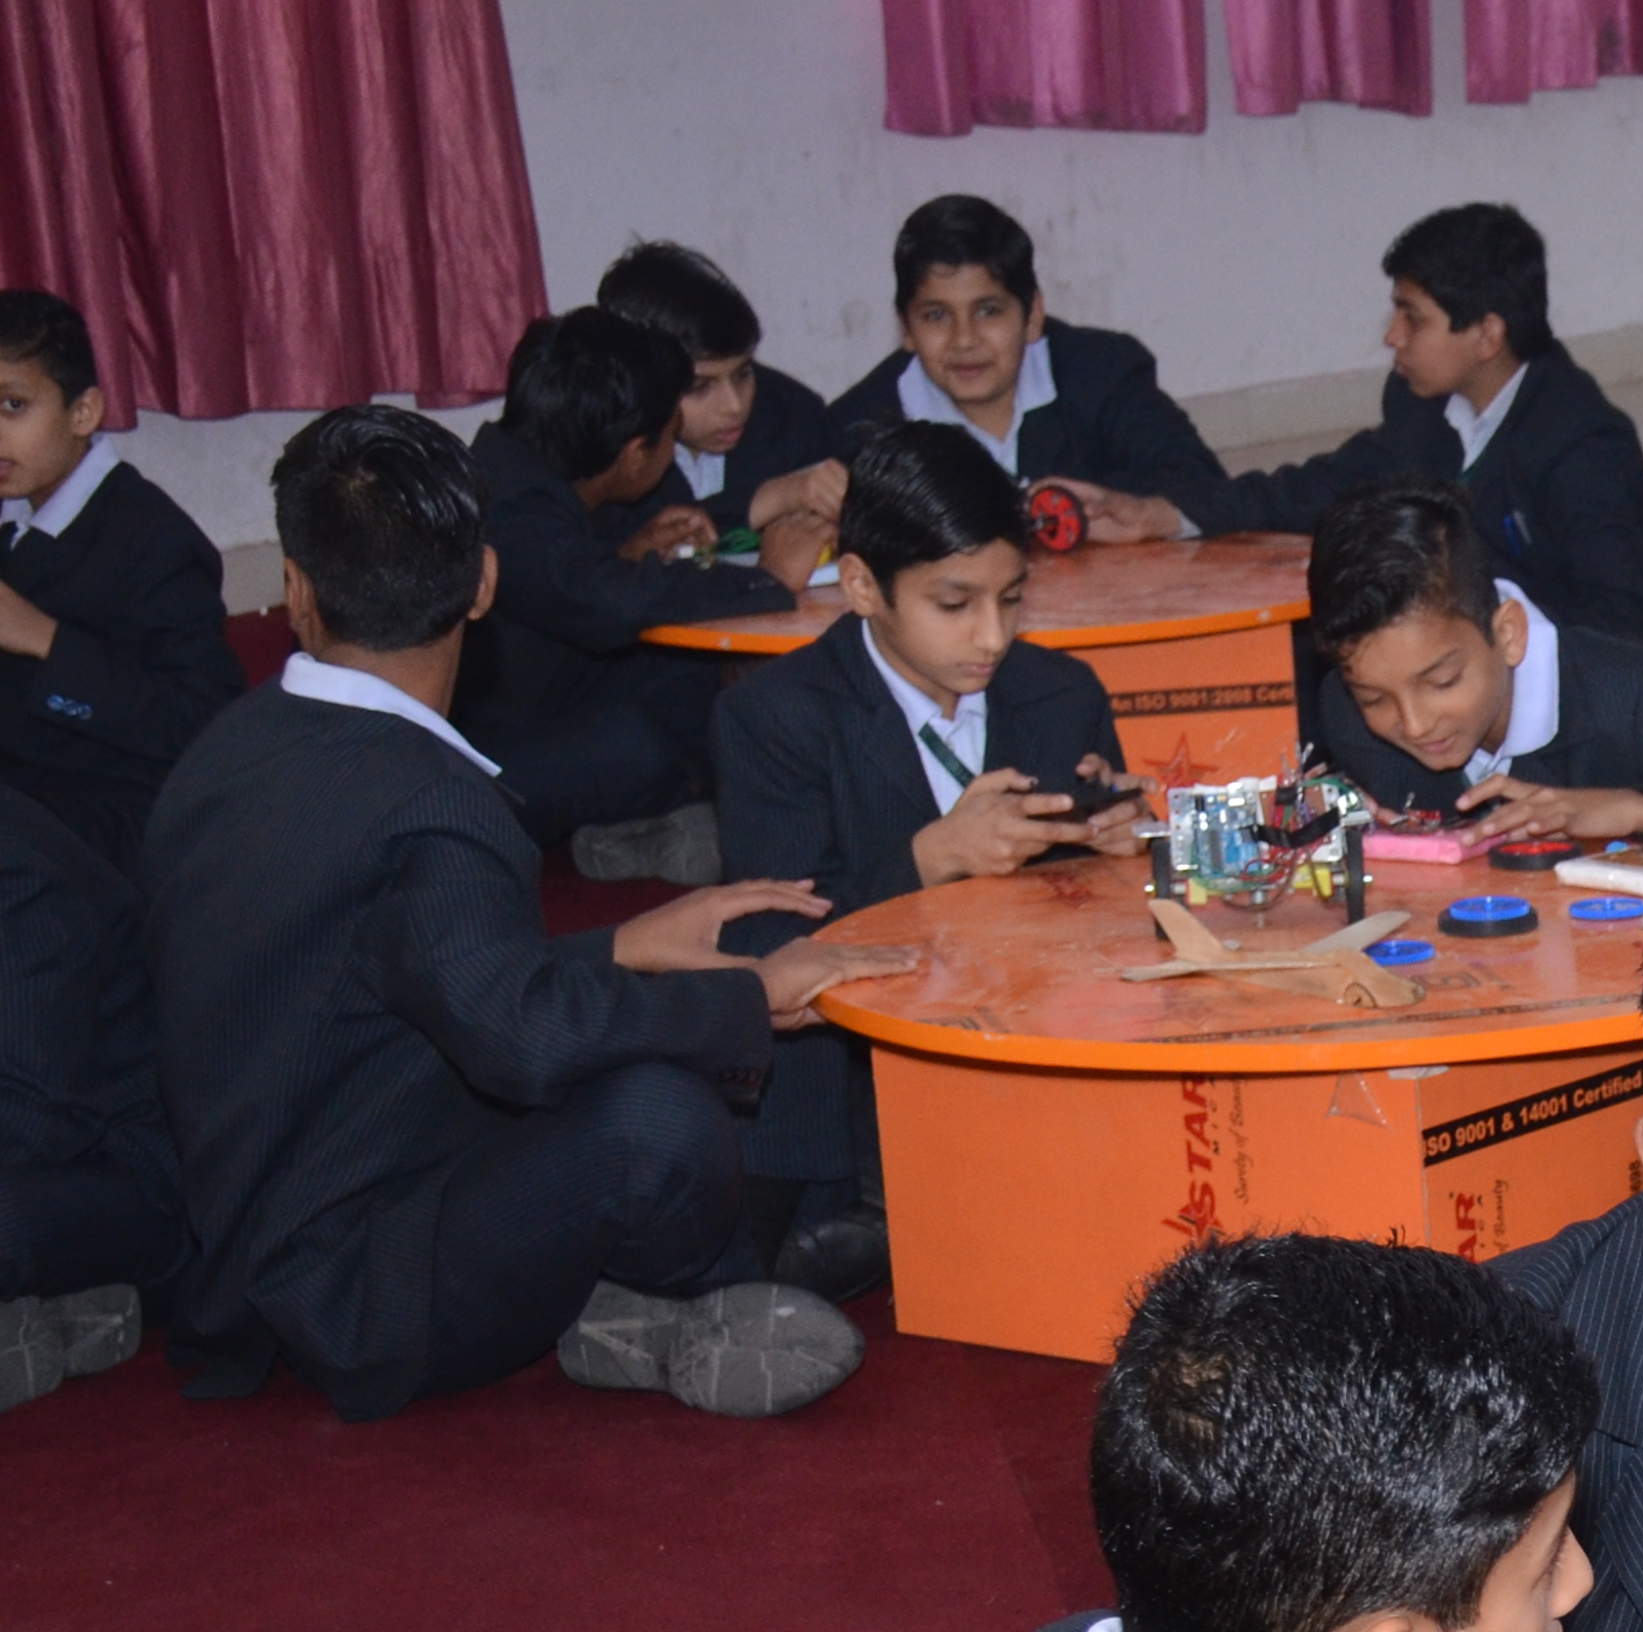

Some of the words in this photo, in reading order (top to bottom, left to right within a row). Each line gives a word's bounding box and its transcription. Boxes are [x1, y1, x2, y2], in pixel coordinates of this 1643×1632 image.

[1454, 1118, 1496, 1148] 9001
[1500, 1112, 1515, 1132] &
[1518, 1093, 1569, 1126] 14001
[1572, 1069, 1643, 1109] Certified
